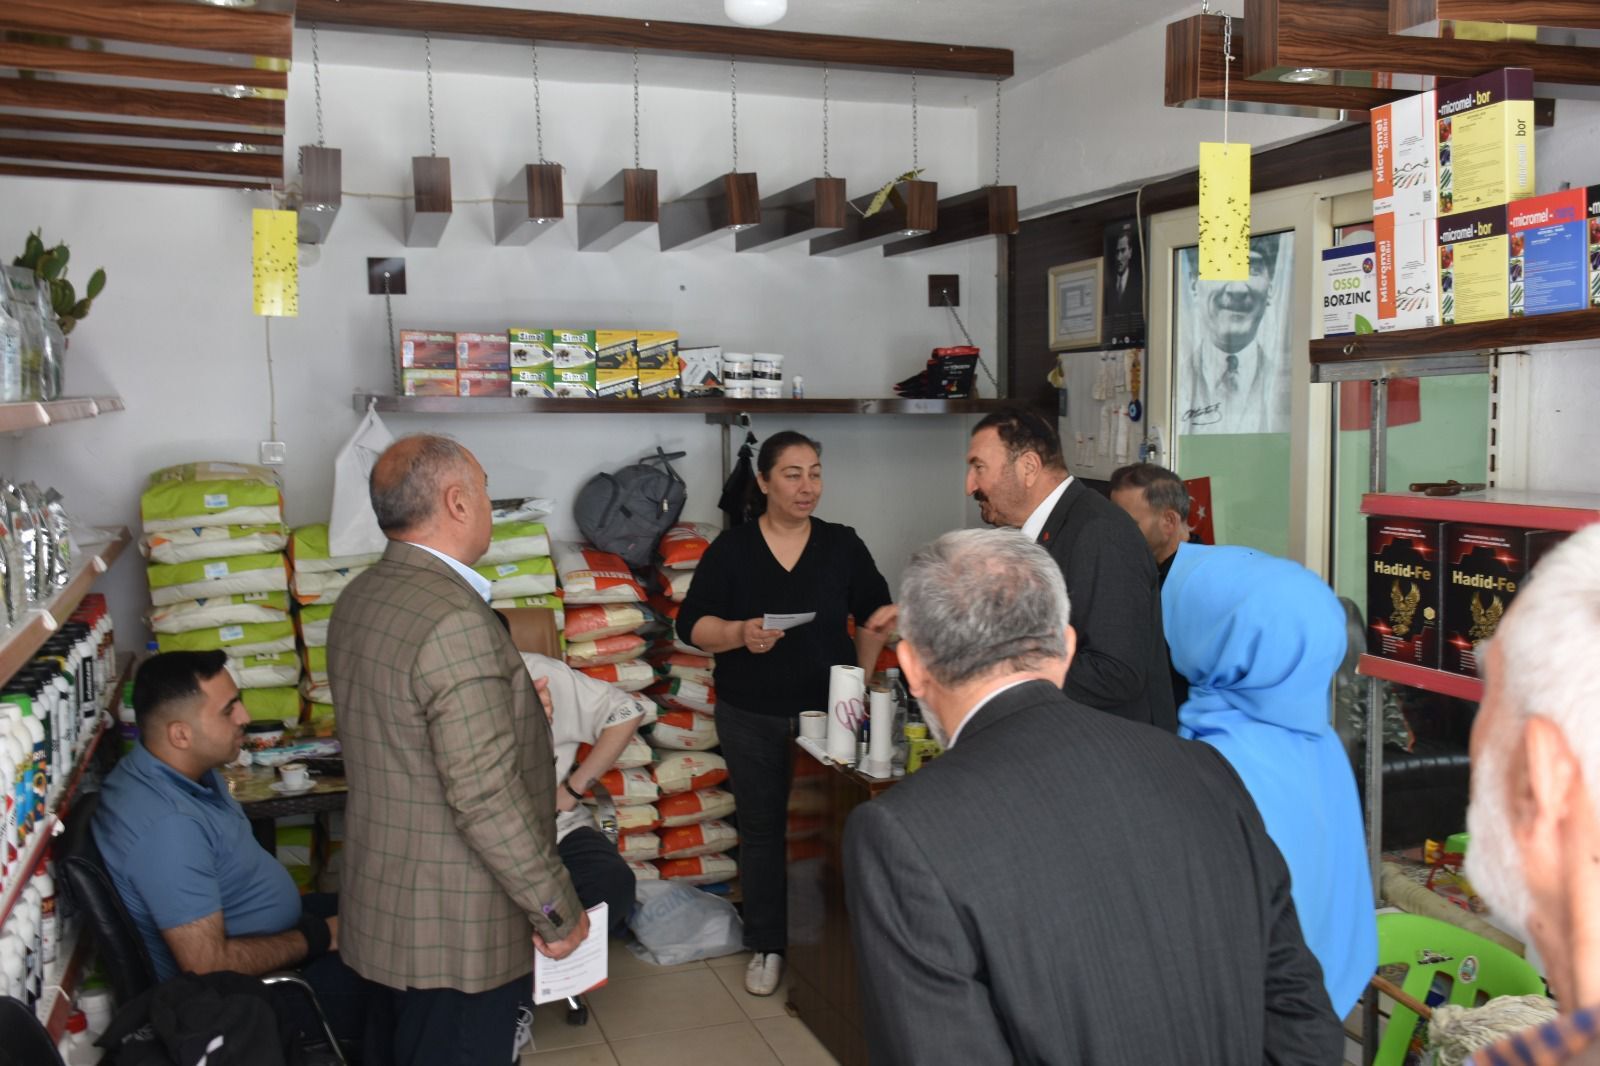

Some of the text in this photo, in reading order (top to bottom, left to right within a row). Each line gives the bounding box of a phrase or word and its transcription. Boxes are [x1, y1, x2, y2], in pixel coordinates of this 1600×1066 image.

[1515, 119, 1526, 137] bor
[1333, 277, 1361, 291] OSSO
[1323, 290, 1371, 308] BORZINC
[1374, 560, 1431, 581] Hadid-Fe
[1452, 570, 1516, 593] Hadid-Fe
